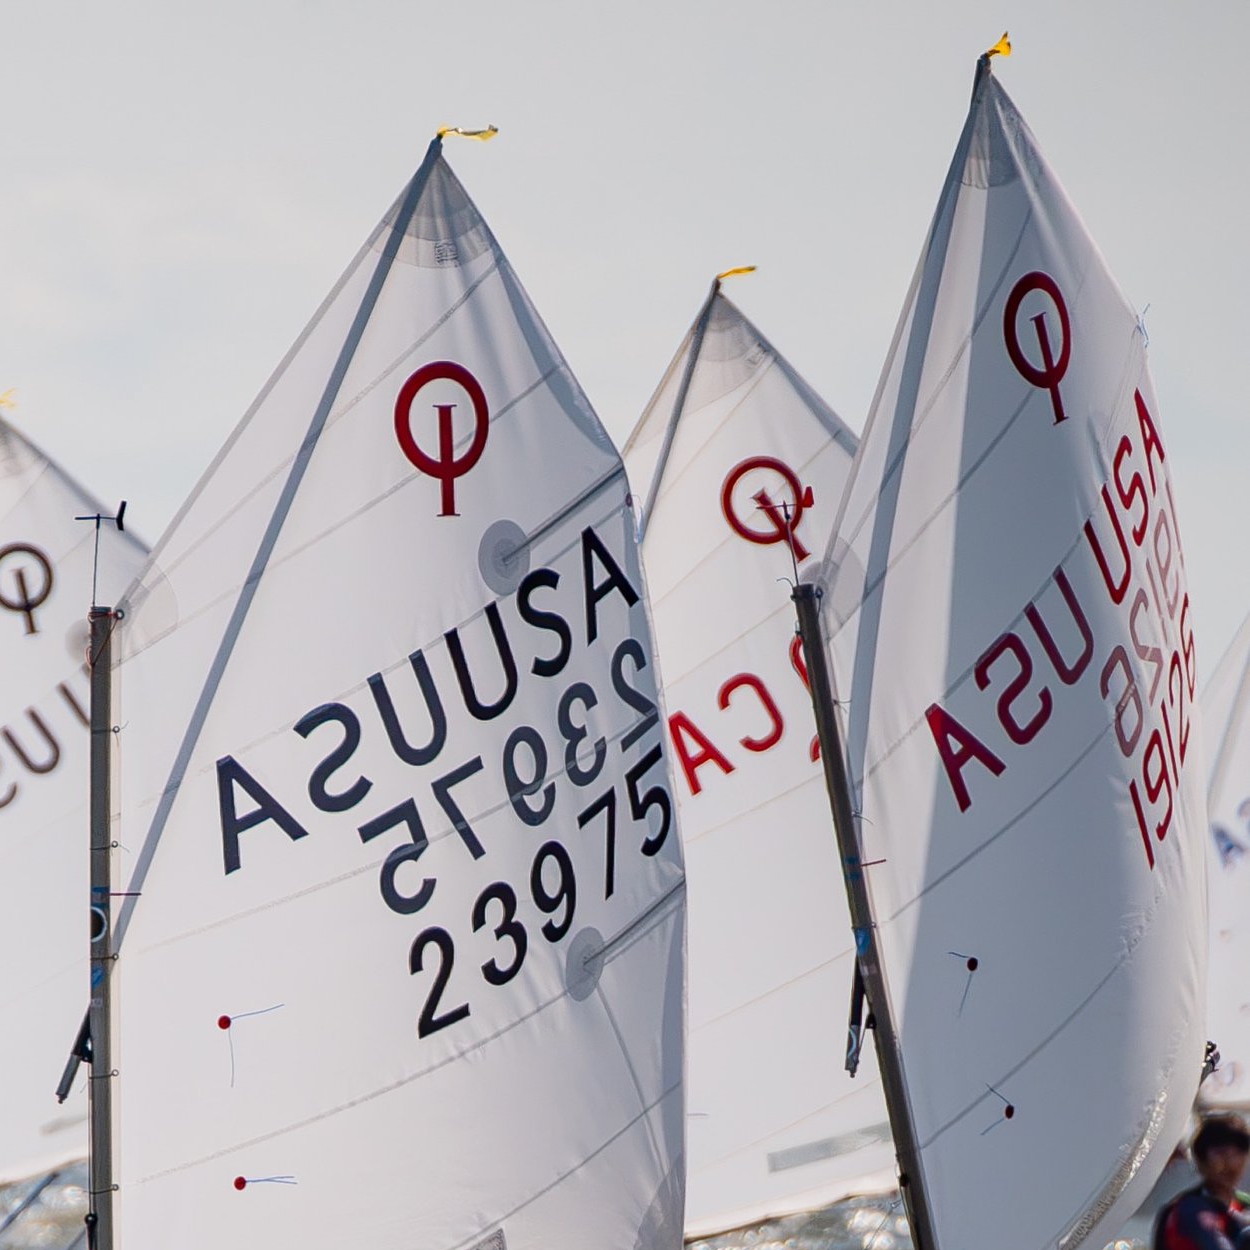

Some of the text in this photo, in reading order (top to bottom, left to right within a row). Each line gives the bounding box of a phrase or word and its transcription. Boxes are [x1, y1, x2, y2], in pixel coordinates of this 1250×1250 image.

[1083, 387, 1166, 605] USA
[443, 525, 640, 721] USA
[409, 742, 673, 1040] 23975
